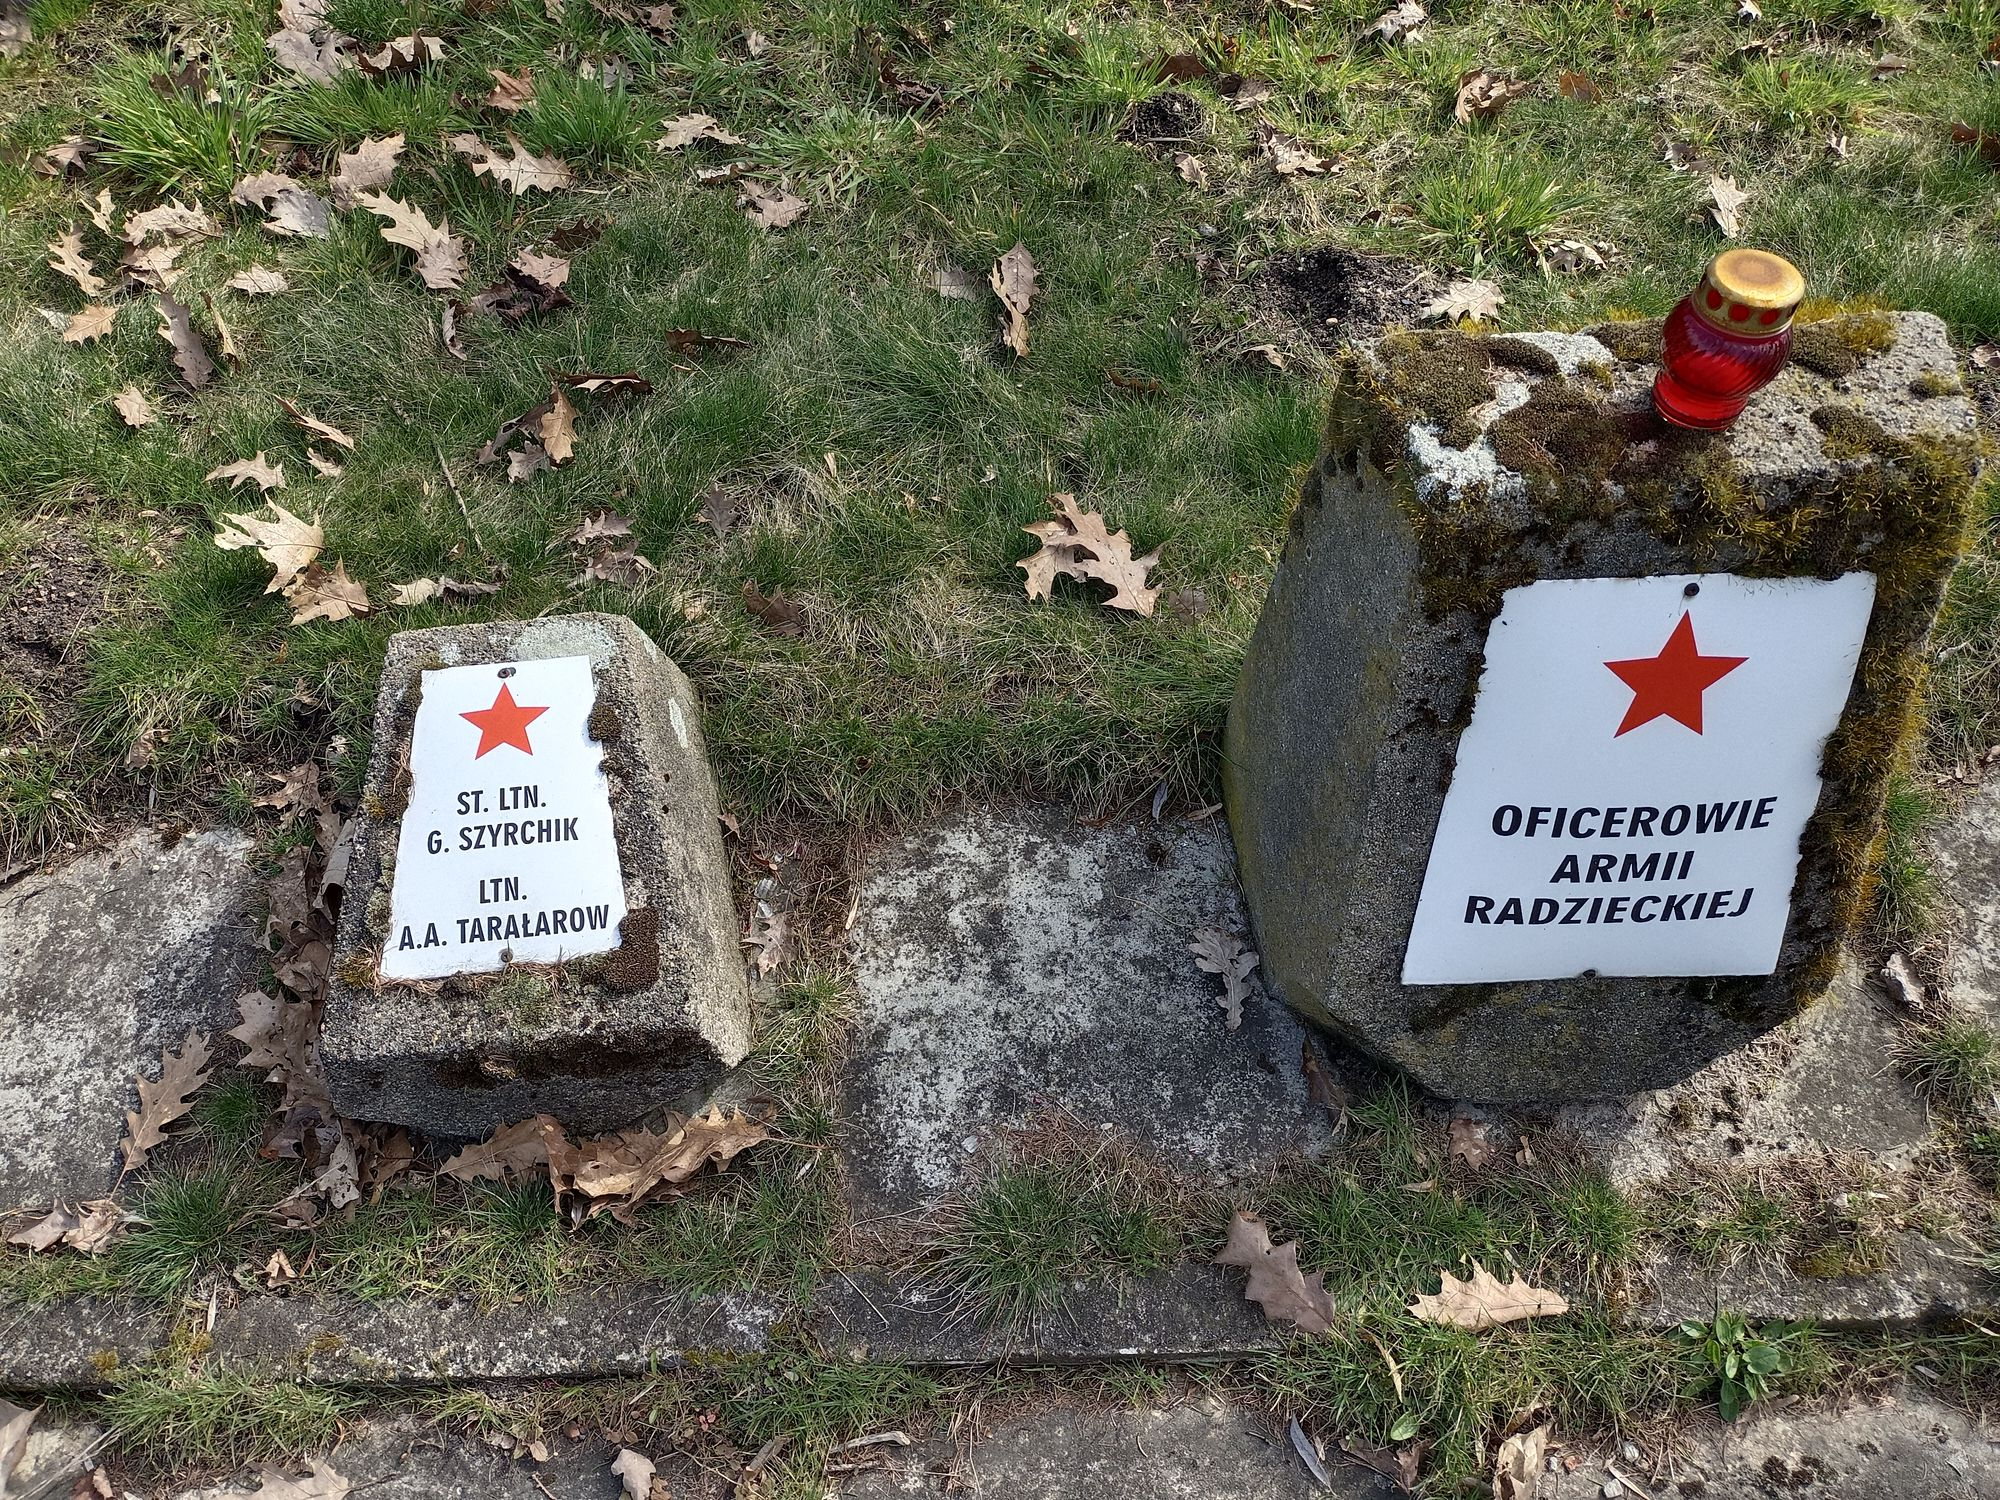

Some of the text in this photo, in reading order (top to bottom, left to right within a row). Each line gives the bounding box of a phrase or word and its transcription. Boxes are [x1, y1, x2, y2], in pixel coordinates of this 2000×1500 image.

[457, 784, 547, 815] ST. LTN.
[1491, 796, 1778, 839] OFICEROWIE
[427, 817, 579, 855] G. SZYRCHIK
[1549, 850, 1695, 884] ARMII
[479, 876, 528, 904] LTN.
[1463, 887, 1755, 925] RADZIECKIEJ
[398, 904, 609, 951] A.A. TARAŁAROW
